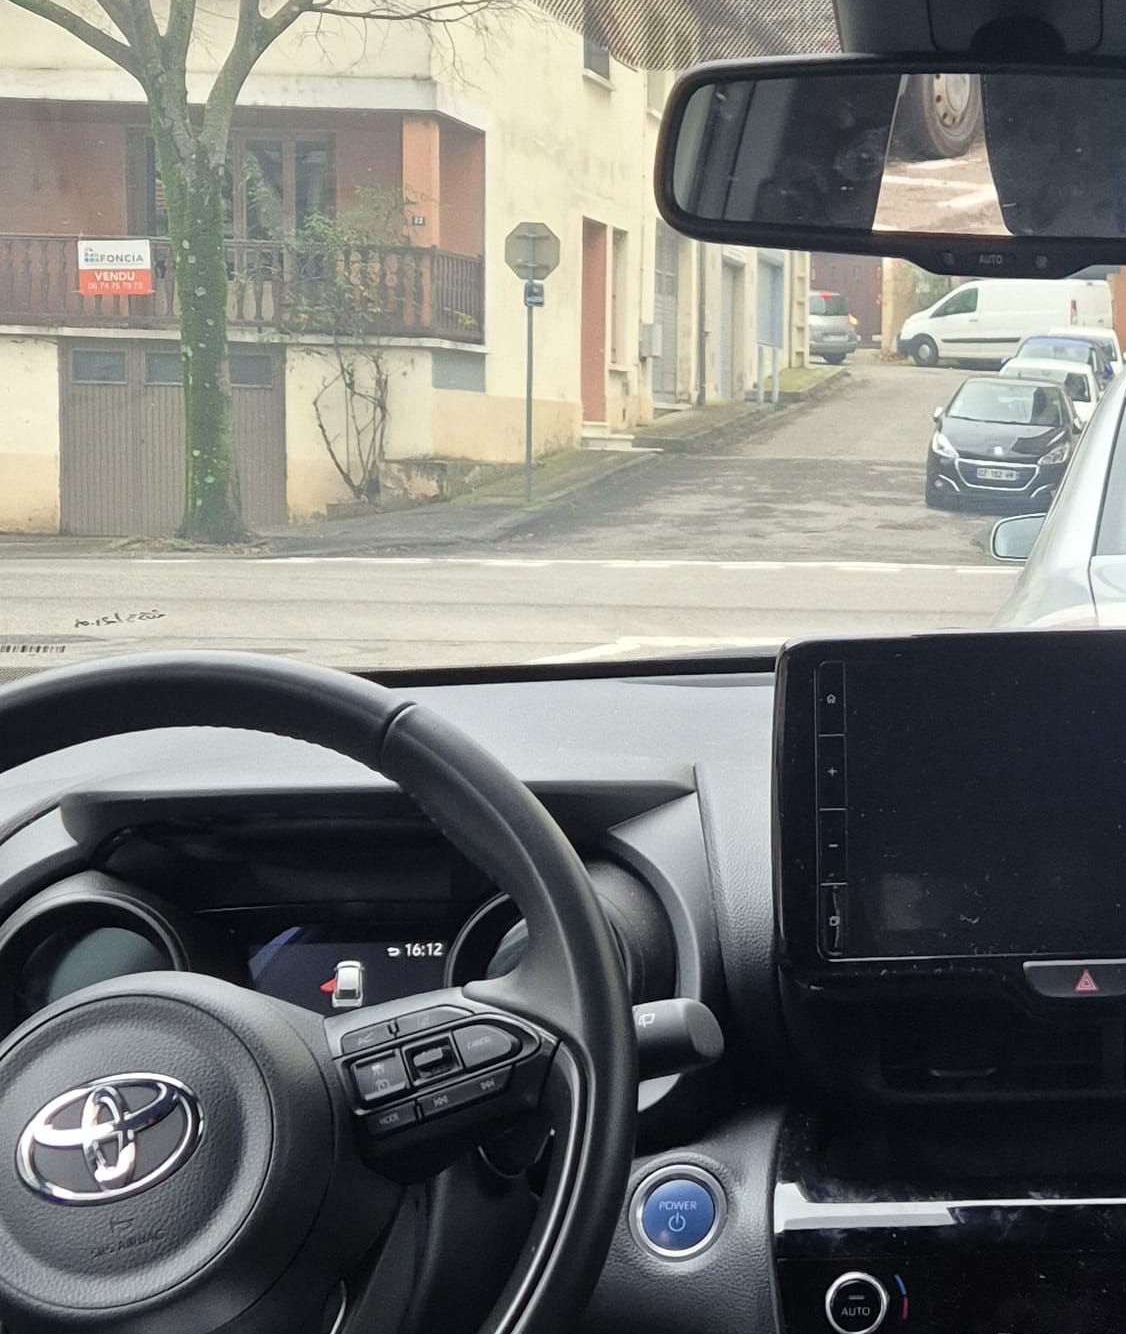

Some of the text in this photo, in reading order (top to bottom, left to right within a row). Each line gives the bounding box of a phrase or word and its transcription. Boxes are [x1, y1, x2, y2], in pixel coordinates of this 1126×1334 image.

[100, 254, 144, 263] FONCIA
[979, 254, 1003, 264] AUTO
[95, 271, 135, 281] VENDU
[404, 942, 443, 957] 16:12
[467, 1035, 492, 1049] CANCEL
[379, 1112, 400, 1125] MODE
[658, 1200, 697, 1210] POWER
[841, 1306, 871, 1317] AUTO
